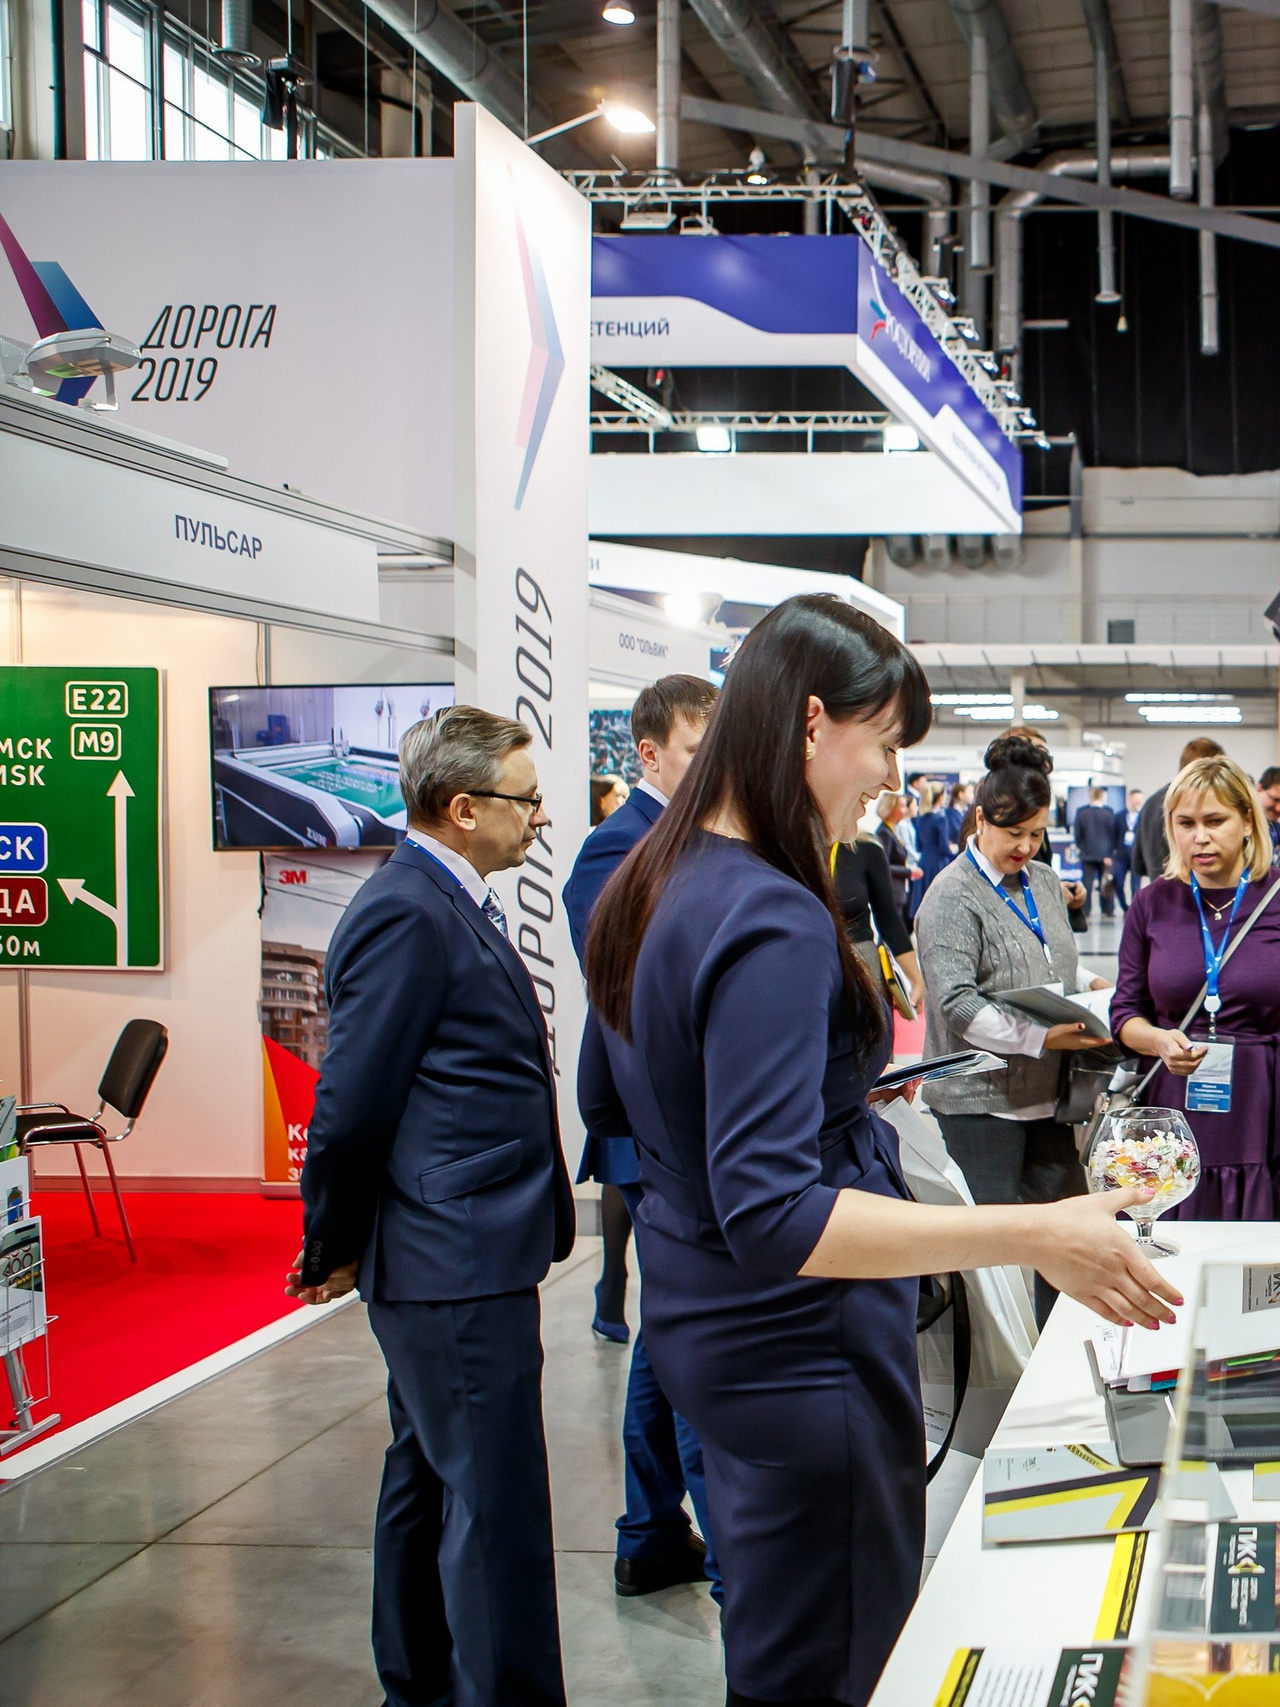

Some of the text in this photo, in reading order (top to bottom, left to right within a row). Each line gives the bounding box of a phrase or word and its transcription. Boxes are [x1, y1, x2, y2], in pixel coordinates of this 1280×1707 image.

[140, 304, 277, 352] ДОРОГА
[590, 316, 669, 338] ТЕНЦИЙ
[131, 357, 218, 401] 2019
[175, 514, 262, 559] ПУЛЬСАР
[515, 567, 552, 750] 2019
[72, 688, 121, 711] E22
[1237, 1527, 1258, 1559] ПИК
[1071, 1653, 1104, 1699] ПИК
